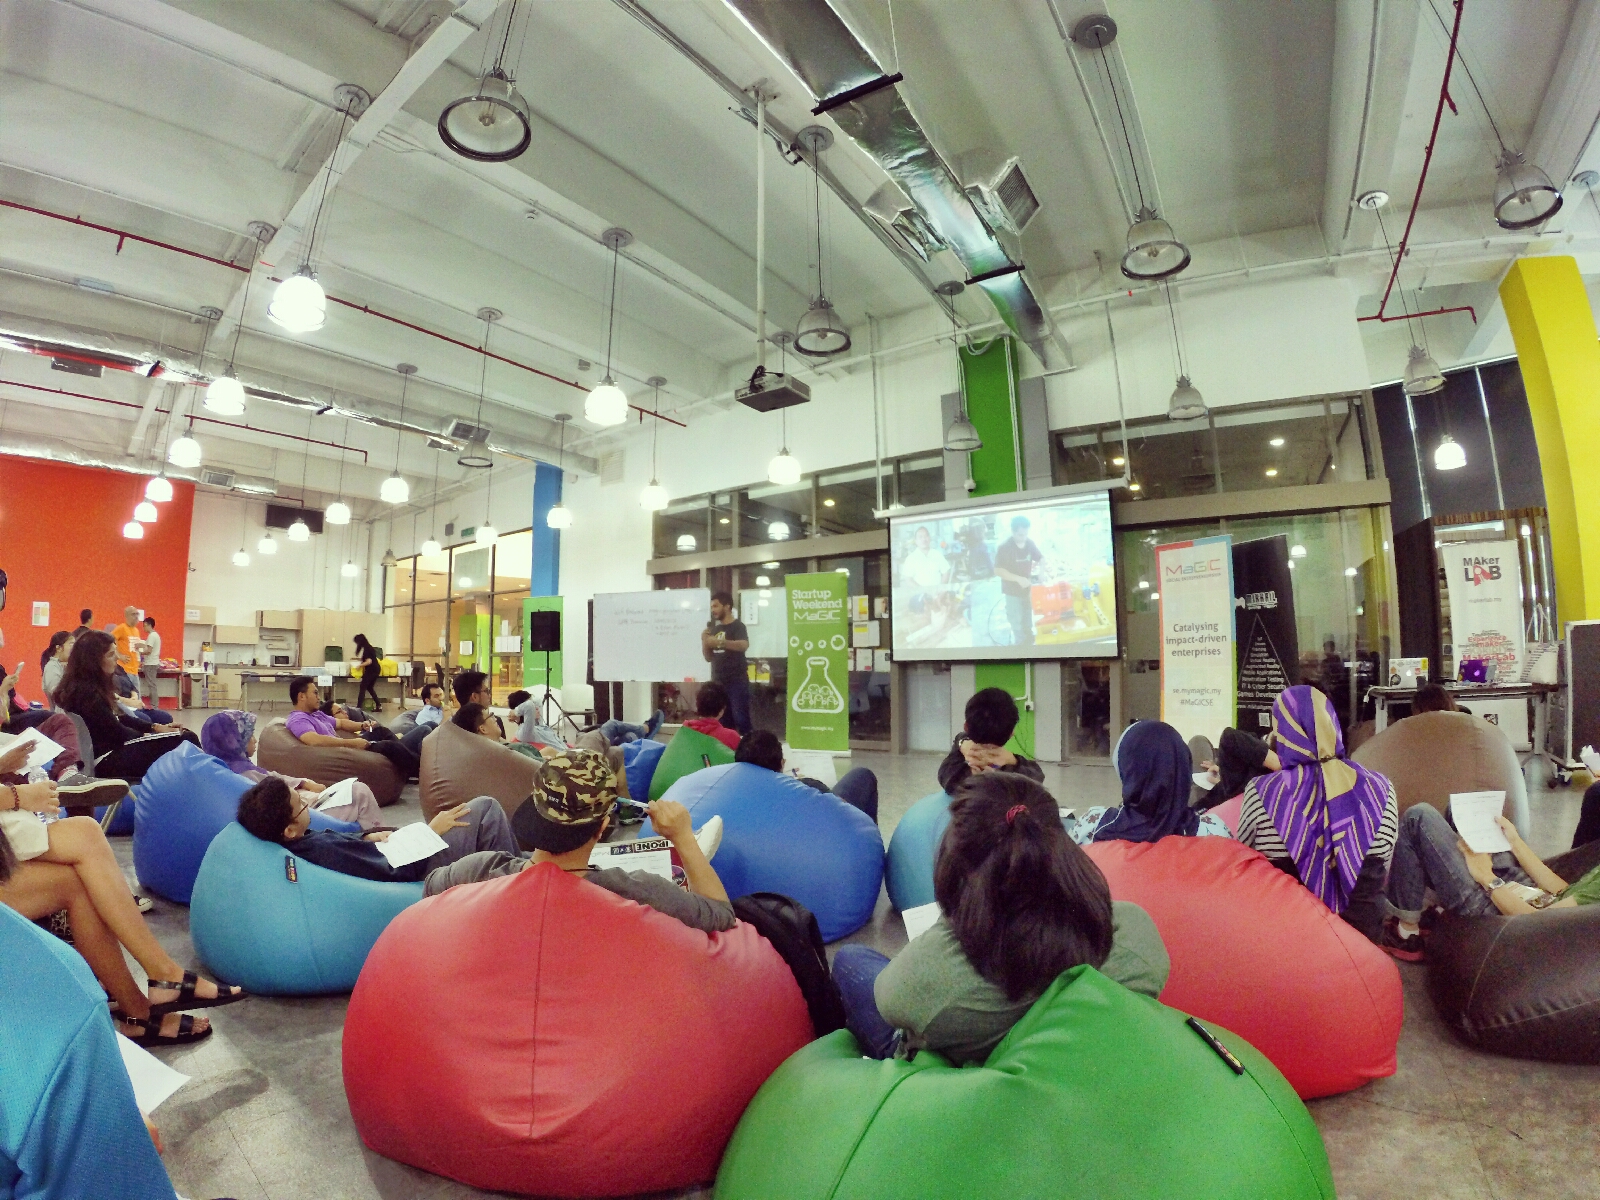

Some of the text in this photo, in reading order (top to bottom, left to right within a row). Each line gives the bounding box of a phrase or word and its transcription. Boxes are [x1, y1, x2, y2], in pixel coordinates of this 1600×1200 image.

[1166, 559, 1221, 576] MaGIC
[792, 589, 832, 600] Startup
[792, 598, 843, 610] Weekend
[793, 609, 841, 621] MaGIC
[1173, 621, 1219, 634] Catalysing
[1165, 633, 1227, 646] impact-driven
[1171, 646, 1221, 658] enterprises
[1172, 687, 1222, 696] se.mymagic.my
[1180, 698, 1214, 707] #MaGICSE
